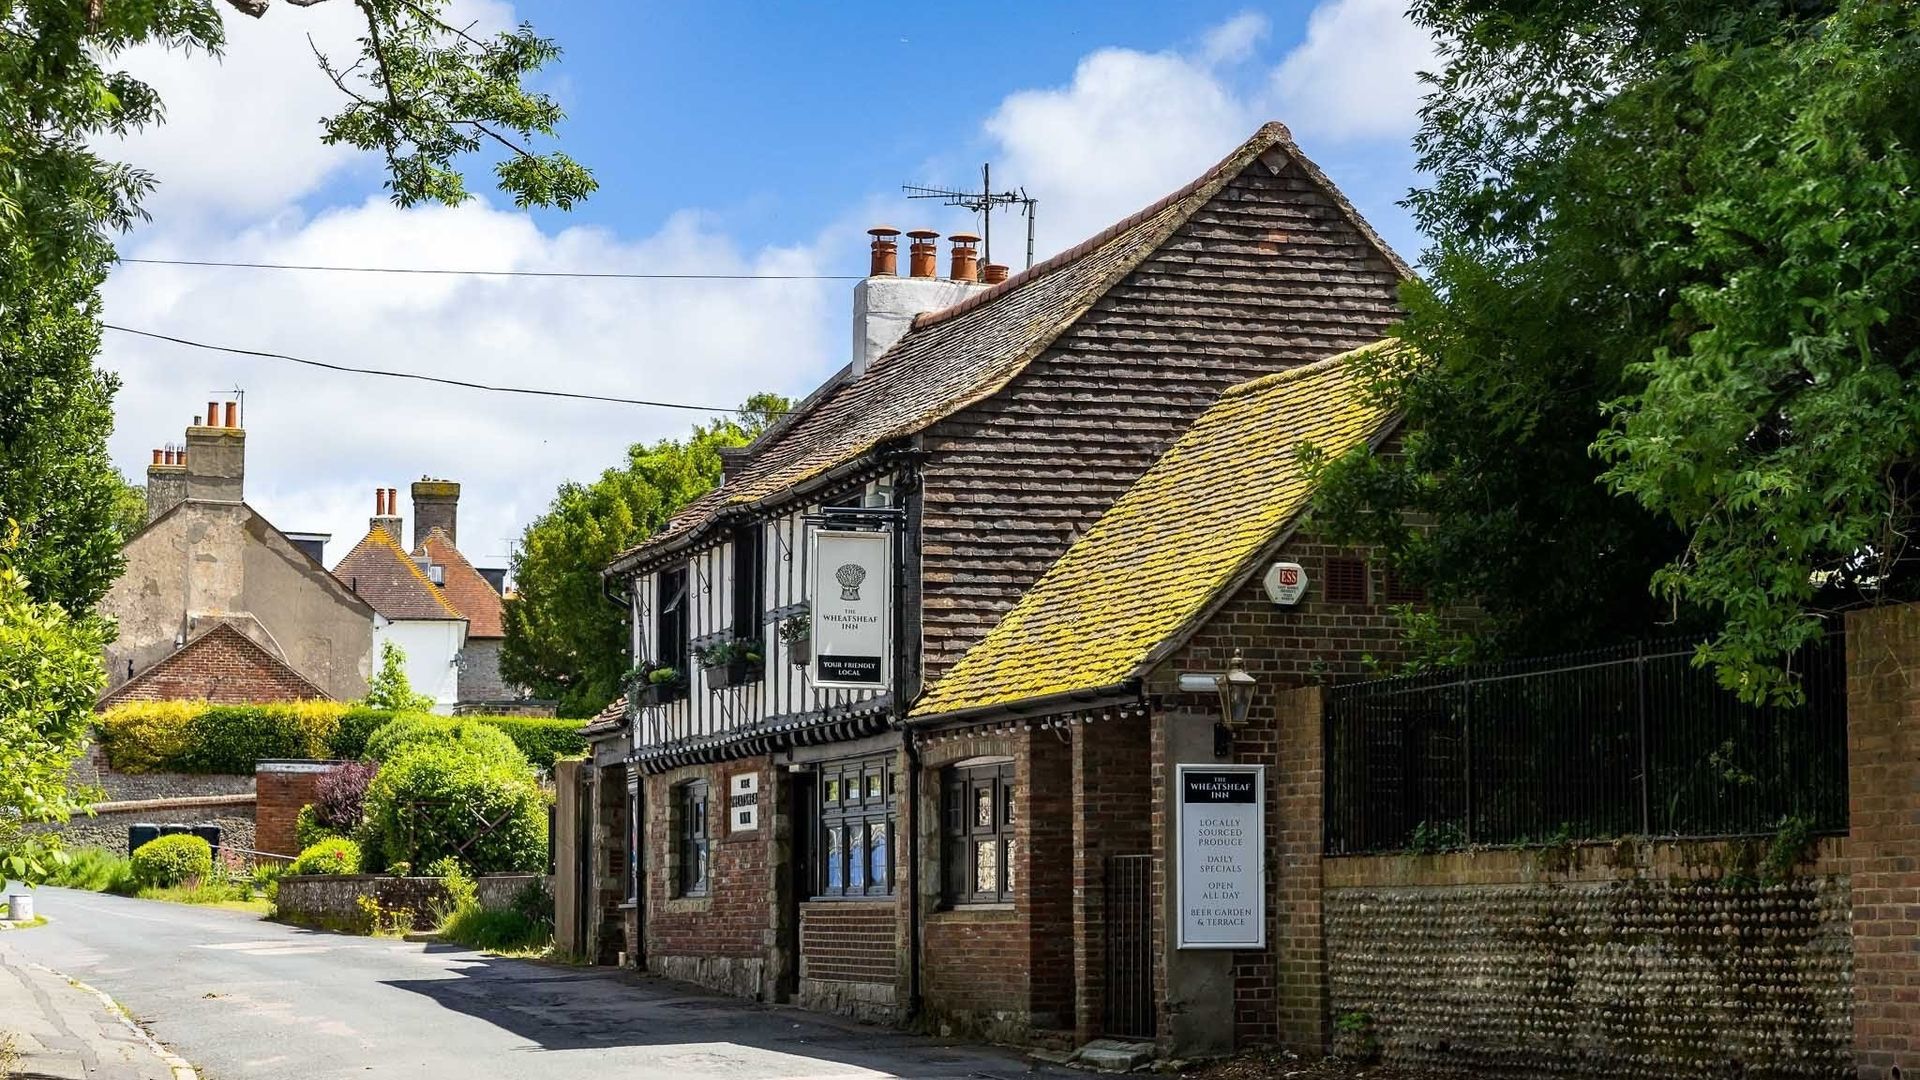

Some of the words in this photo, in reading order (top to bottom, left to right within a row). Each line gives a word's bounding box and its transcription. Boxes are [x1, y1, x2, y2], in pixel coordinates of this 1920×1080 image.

[1281, 570, 1297, 583] ESS
[823, 614, 878, 623] WHEATSHEAF
[1190, 782, 1251, 791] WHEATSHEAF
[1211, 791, 1229, 799] INN
[1200, 819, 1241, 827] LOCALLY
[1198, 828, 1243, 837] SOURCED
[1198, 838, 1243, 846] PRODUCE
[1207, 855, 1234, 863] DAILY
[1200, 865, 1242, 873] SPECIALS
[1208, 881, 1233, 890] OPEN
[1202, 891, 1219, 899] ALL
[1222, 891, 1240, 899] DAY
[1190, 908, 1212, 916] BEER
[1214, 908, 1252, 917] GARDEN
[1197, 918, 1204, 927] &
[1207, 918, 1245, 926] TERRACE
